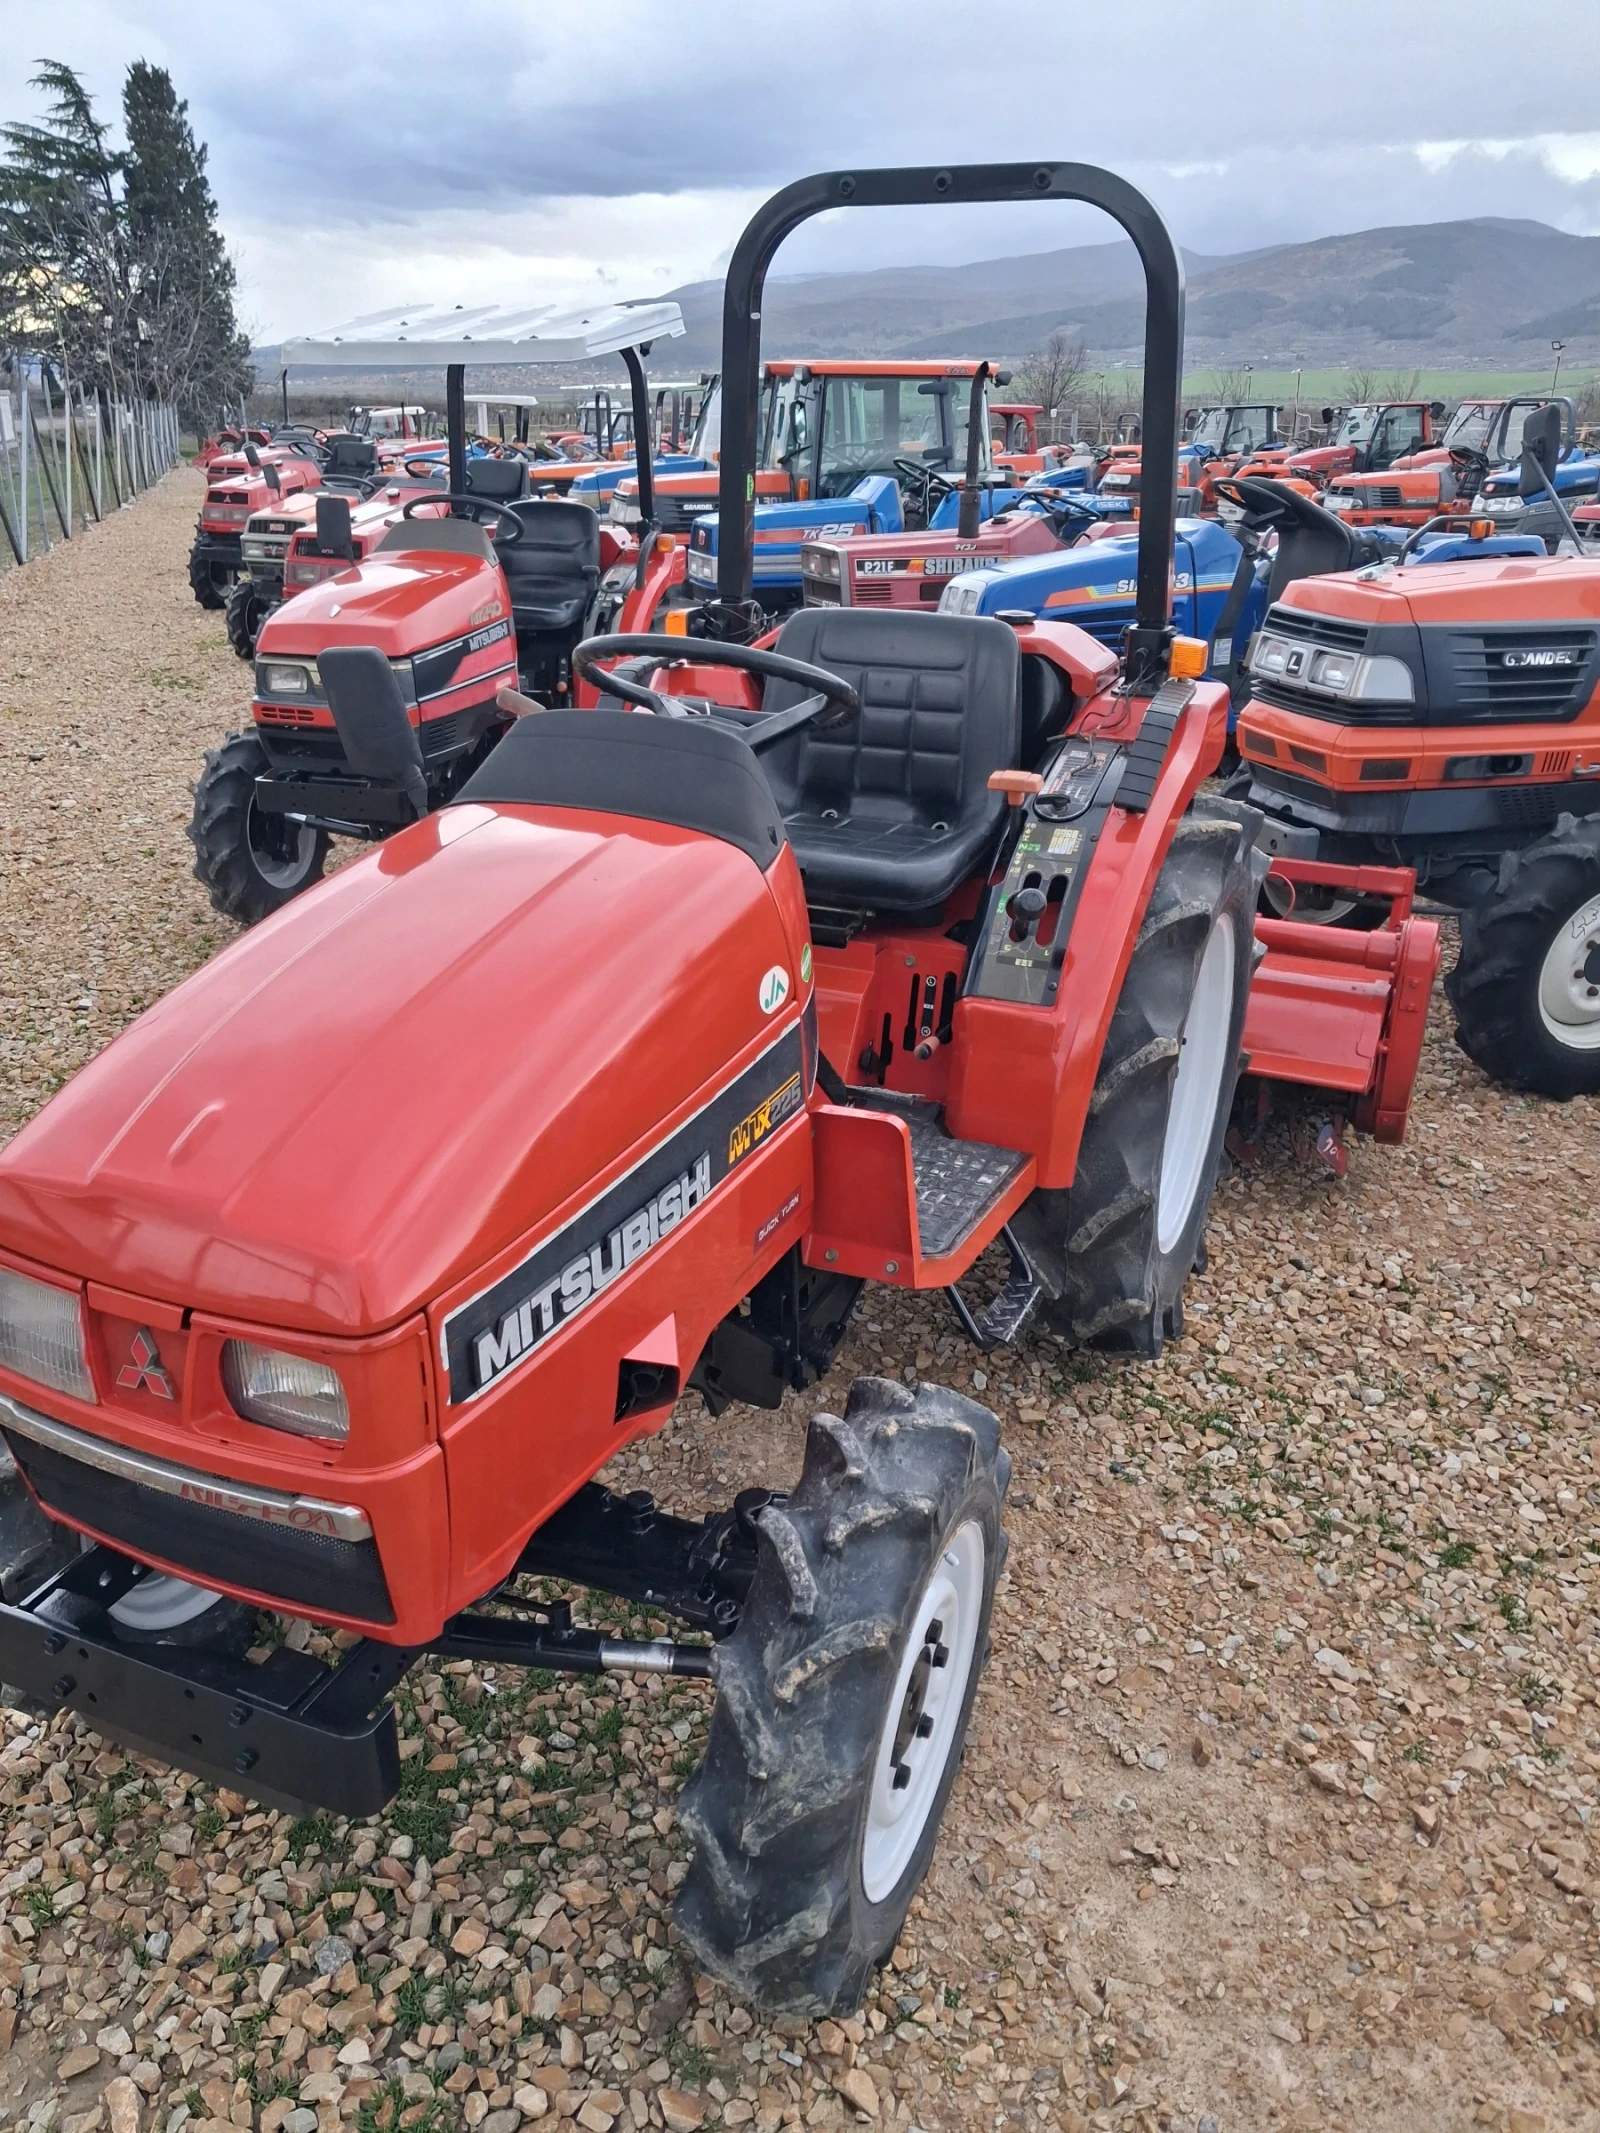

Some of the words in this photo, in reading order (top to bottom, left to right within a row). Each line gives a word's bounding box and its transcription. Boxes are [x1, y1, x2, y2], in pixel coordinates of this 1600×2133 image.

[1096, 501, 1128, 509] ISEKI
[801, 523, 856, 541] TK25
[864, 560, 895, 575] P21F
[468, 622, 509, 652] MITSUBISHI
[758, 1213, 780, 1242] QUICK
[781, 1193, 799, 1218] TURN
[474, 1151, 711, 1385] MITSUBISHI
